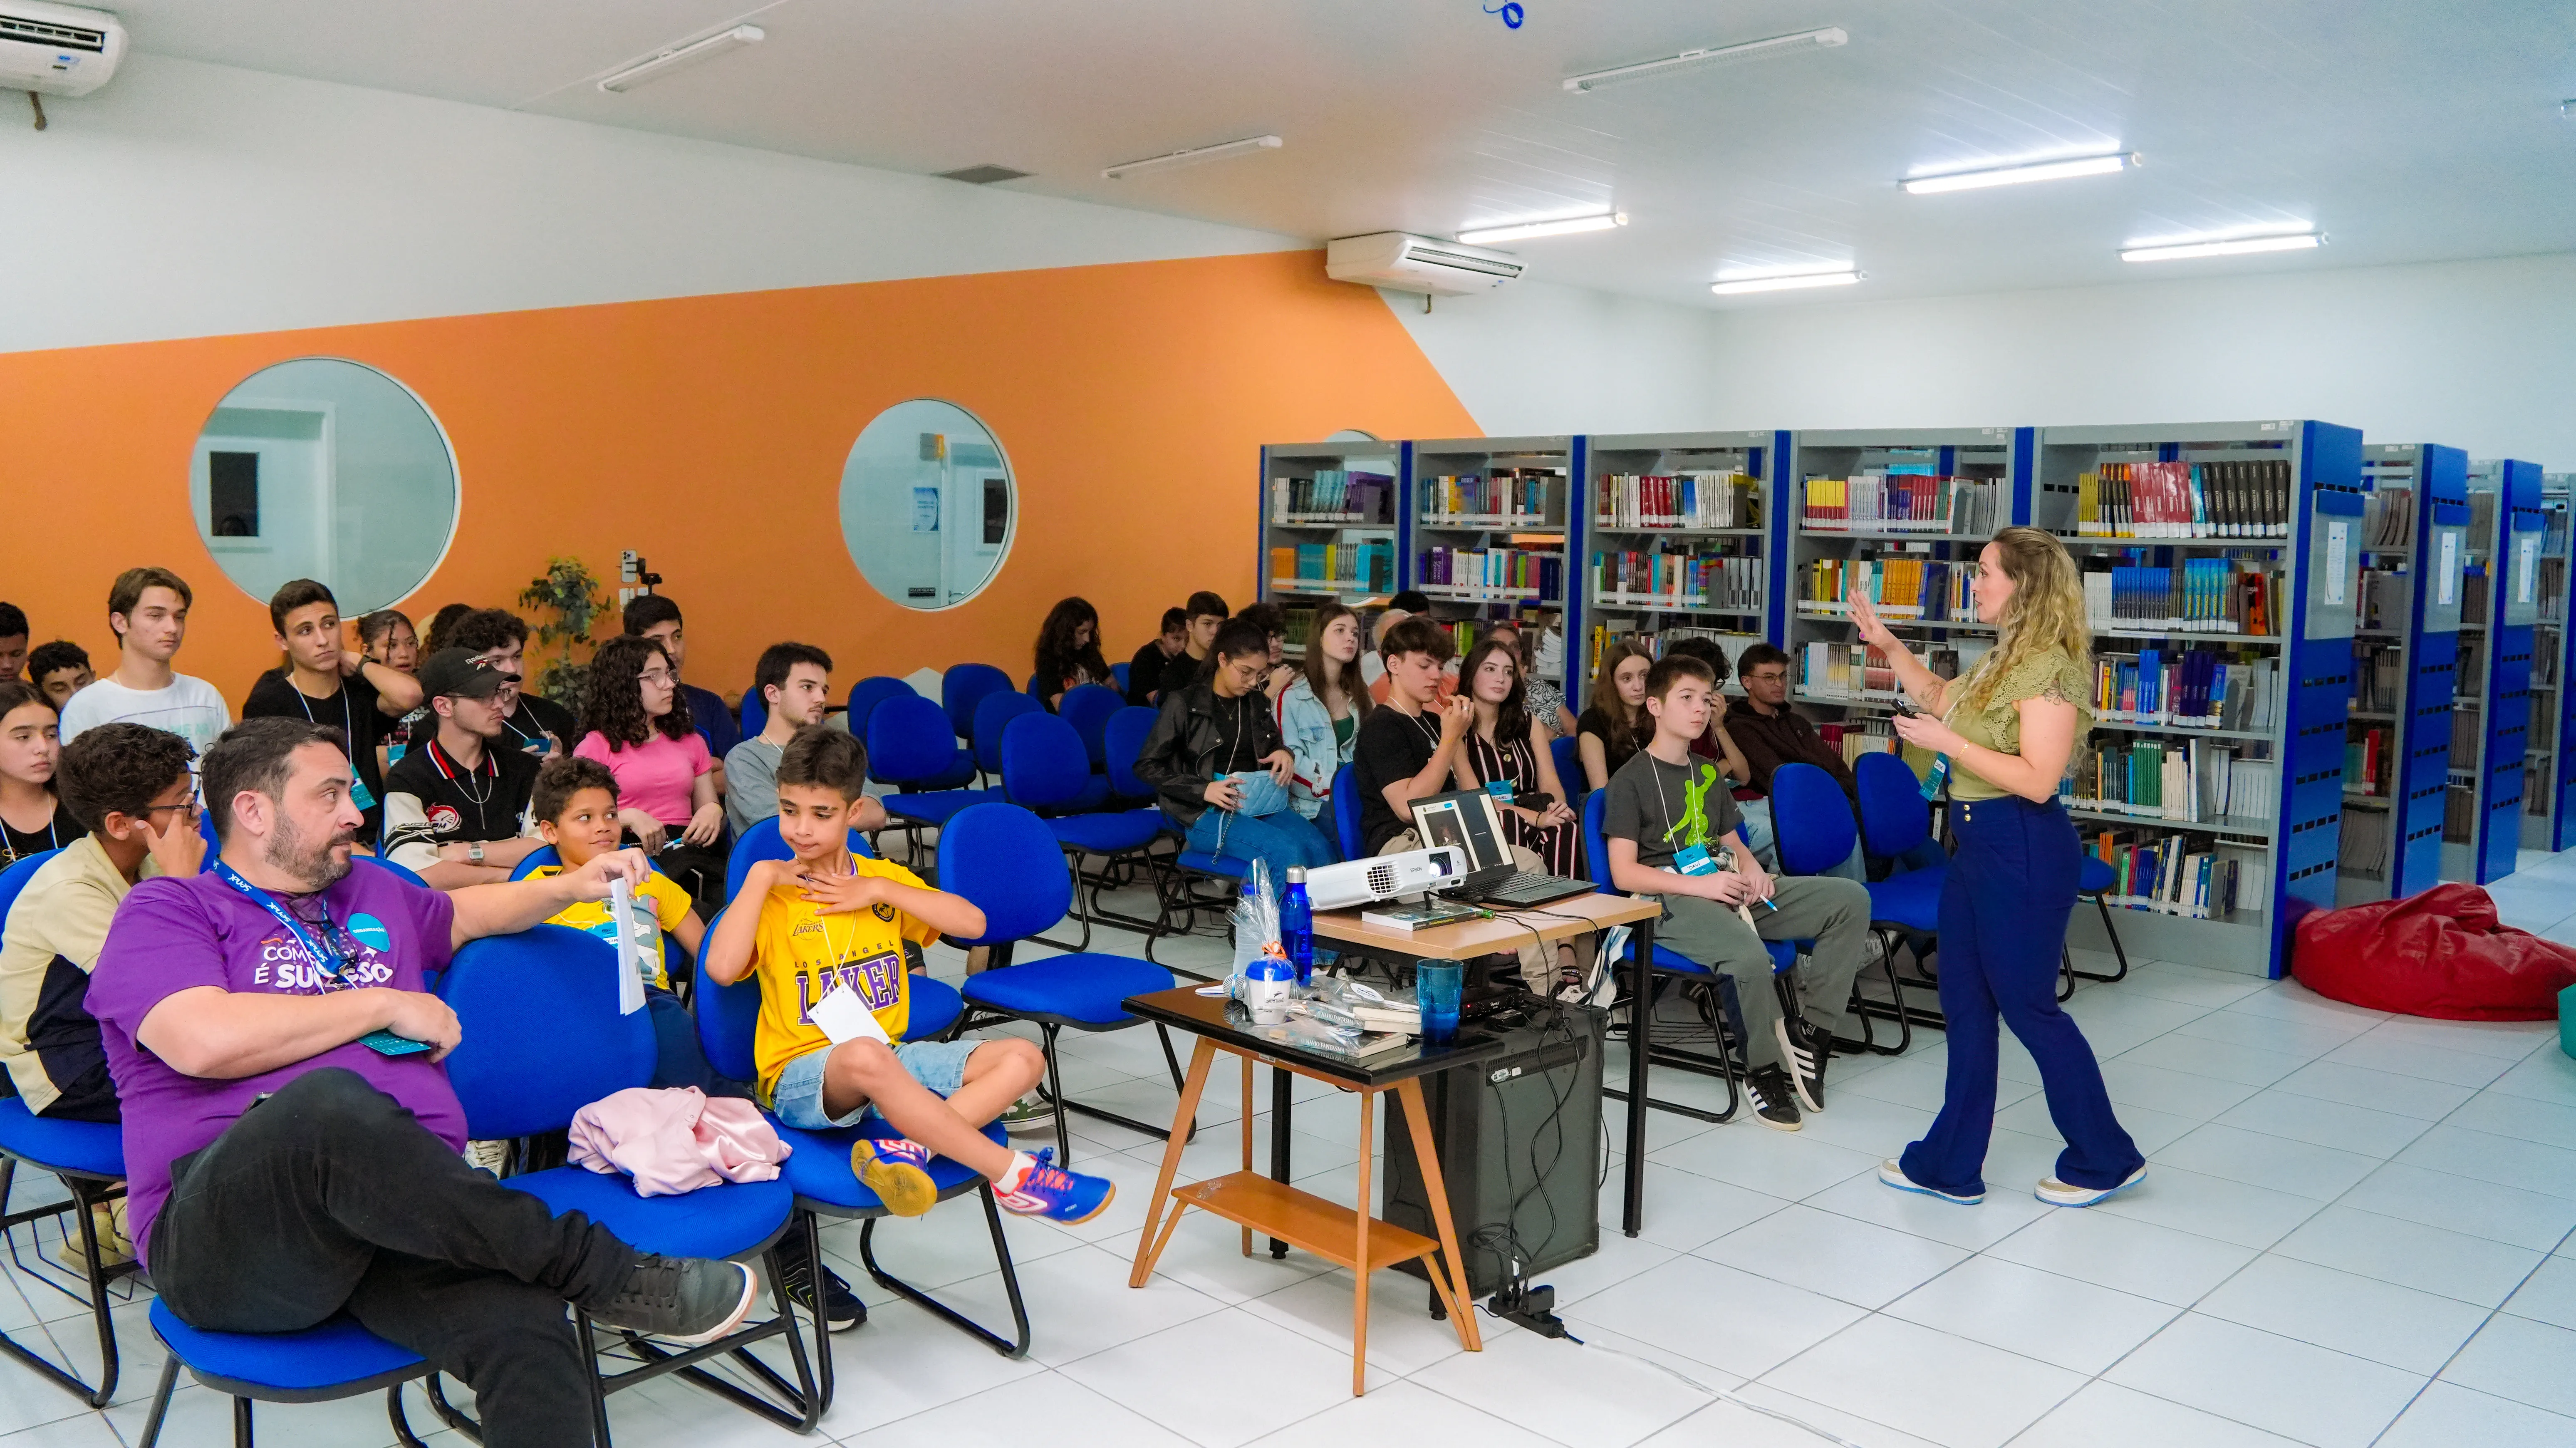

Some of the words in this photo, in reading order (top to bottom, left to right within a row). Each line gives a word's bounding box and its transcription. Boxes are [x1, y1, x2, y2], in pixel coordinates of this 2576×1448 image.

[1688, 861, 1700, 870] DAVI
[791, 922, 824, 937] LAKERS
[795, 959, 821, 968] LOS
[254, 962, 270, 984] É
[275, 961, 393, 989] SUSO
[1333, 1015, 1354, 1024] FANTASMA
[1320, 1042, 1345, 1054] FANTASMA
